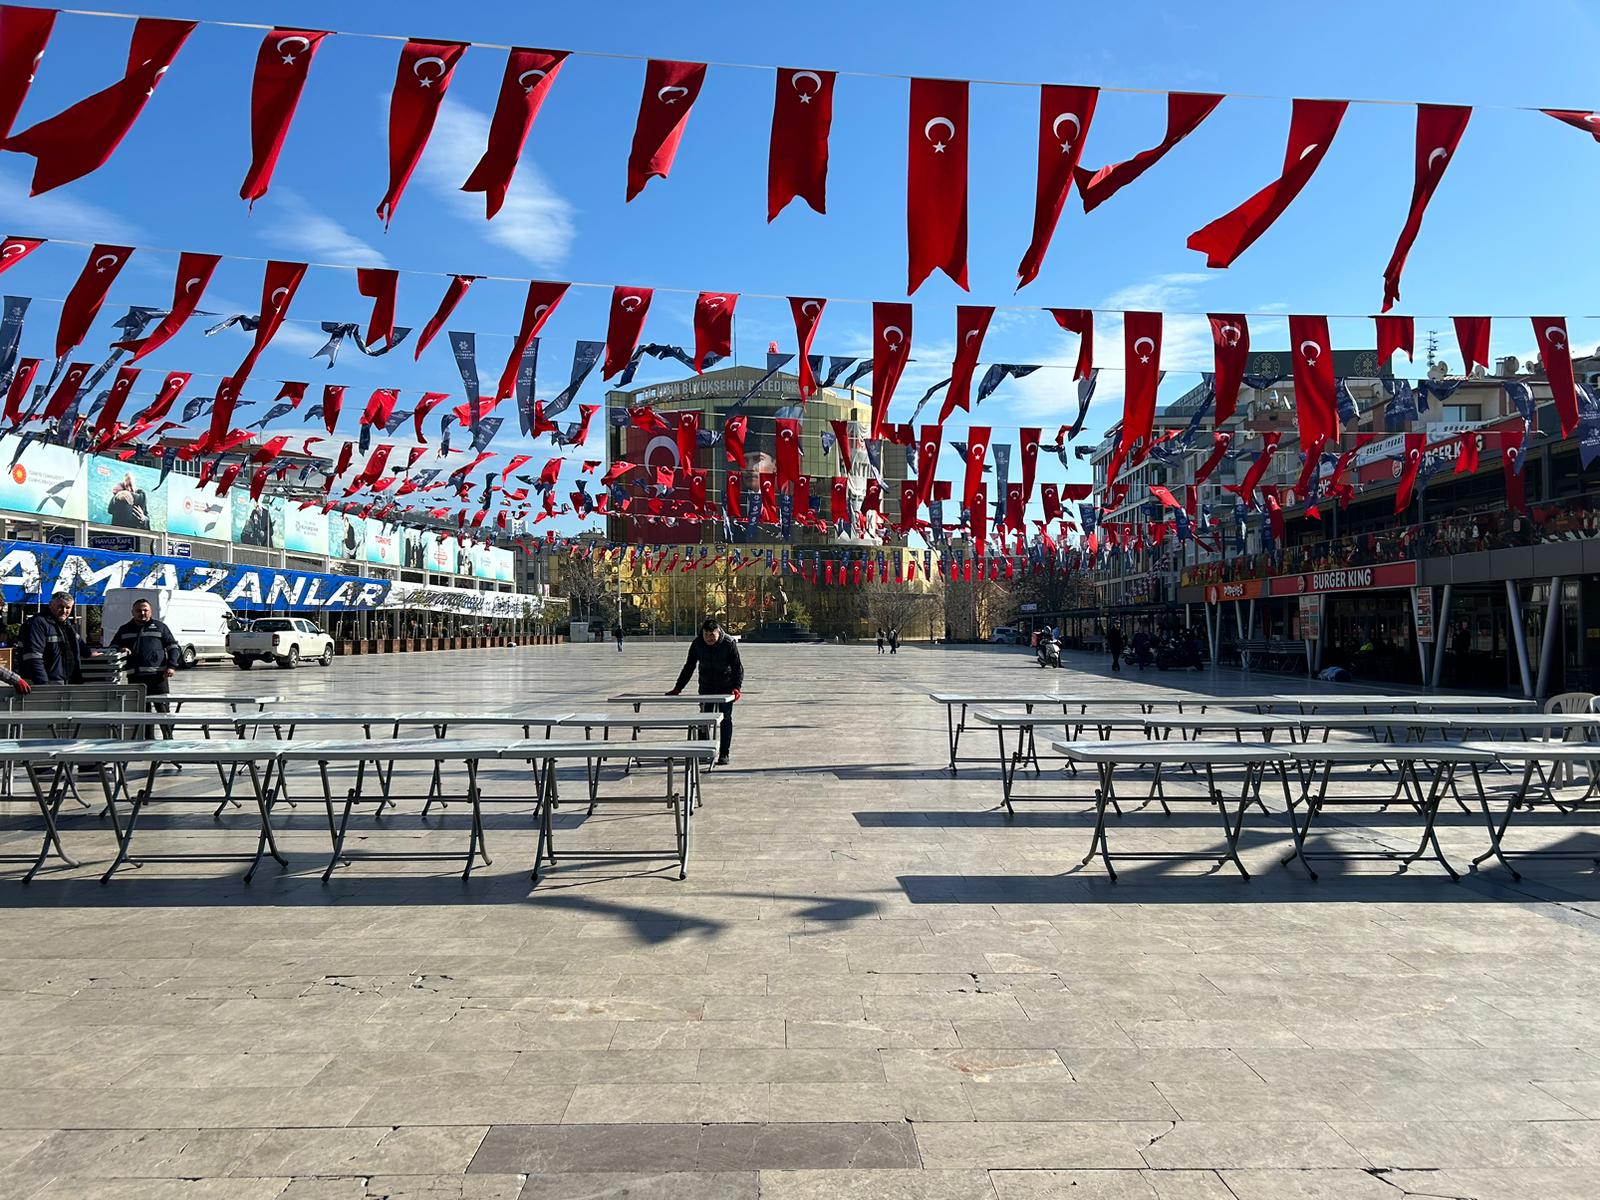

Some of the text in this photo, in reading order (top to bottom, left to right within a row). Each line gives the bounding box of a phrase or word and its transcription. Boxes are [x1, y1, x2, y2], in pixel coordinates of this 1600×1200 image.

[1453, 434, 1483, 458] KG
[1313, 571, 1346, 590] BURGER
[1347, 568, 1371, 587] KING
